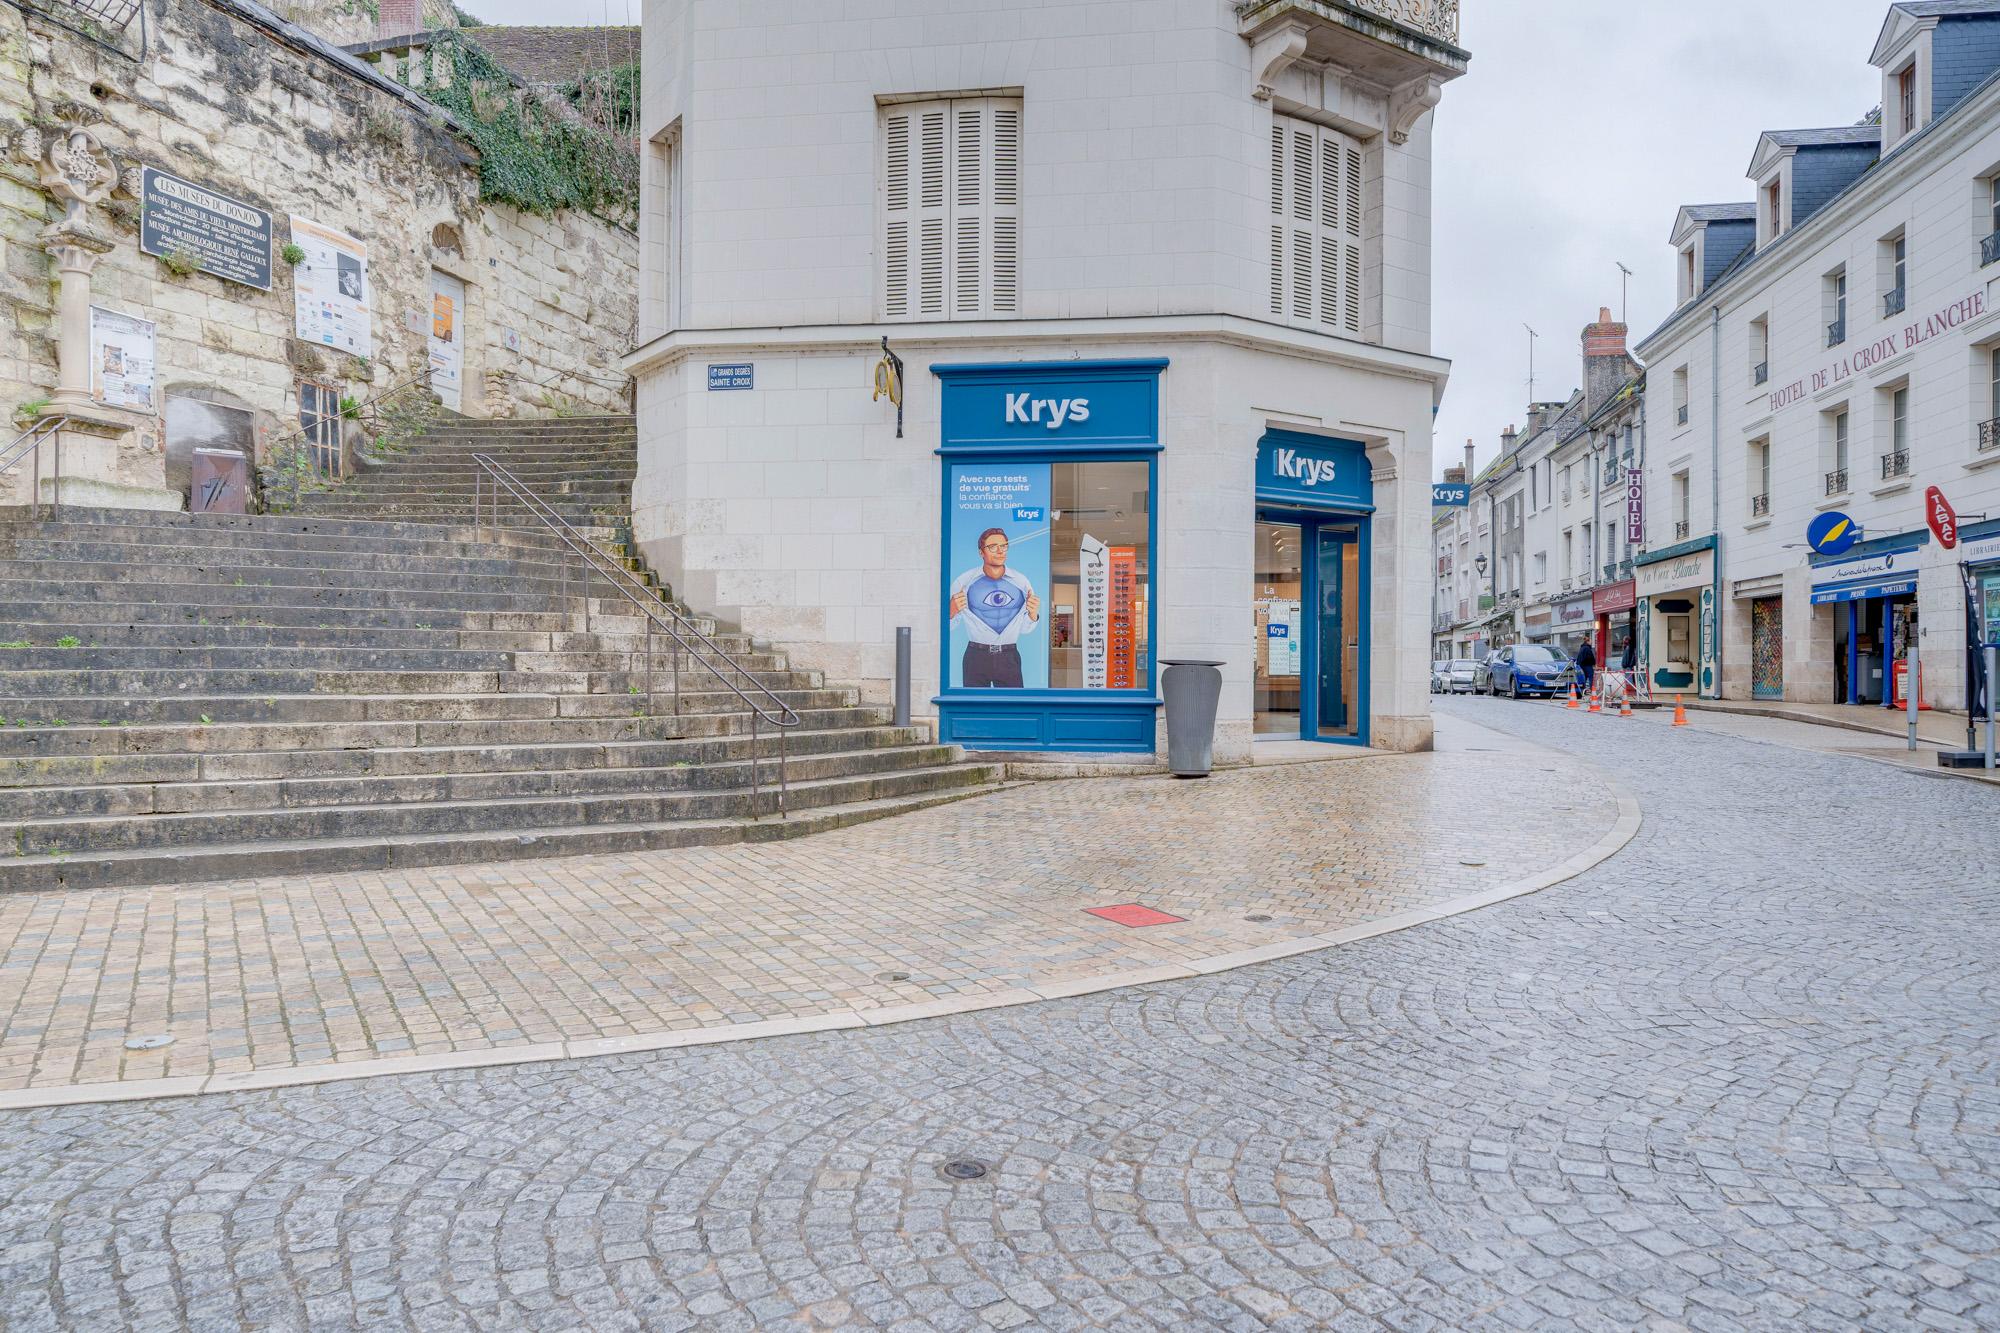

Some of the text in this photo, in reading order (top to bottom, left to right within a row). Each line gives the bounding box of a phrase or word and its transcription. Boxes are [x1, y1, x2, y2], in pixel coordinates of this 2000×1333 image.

[160, 179, 176, 193] LES
[213, 199, 224, 211] DU
[226, 204, 257, 224] DONJON
[150, 211, 181, 226] Collections
[182, 222, 209, 236] anciennes
[171, 201, 183, 211] DES
[184, 206, 199, 219] AMIS
[200, 211, 209, 222] DU
[209, 215, 227, 229] VIEUX
[227, 222, 267, 242] MONTRICHARD
[239, 261, 256, 270] locale
[1769, 290, 1986, 412] HOTEL DE LA CROIX BLANCHE
[710, 377, 751, 387] SAINTE CROIX
[1005, 392, 1090, 430] Krys
[1277, 447, 1336, 486] Krys
[959, 475, 983, 483] Avec
[1004, 475, 1028, 483] tests
[959, 484, 971, 492] de
[959, 493, 1013, 501] la confiance
[1432, 487, 1465, 503] Krys
[1003, 501, 1024, 510] bien
[1628, 473, 1642, 540] HOTEL
[1017, 509, 1040, 520] Krys
[1930, 494, 1954, 541] TABAC
[1970, 543, 2000, 556] LIBRAIRIE
[1672, 556, 1702, 580] Blanche
[1264, 585, 1275, 595] La
[1881, 583, 1908, 594] PAPETERIE
[1270, 626, 1286, 636] Krys
